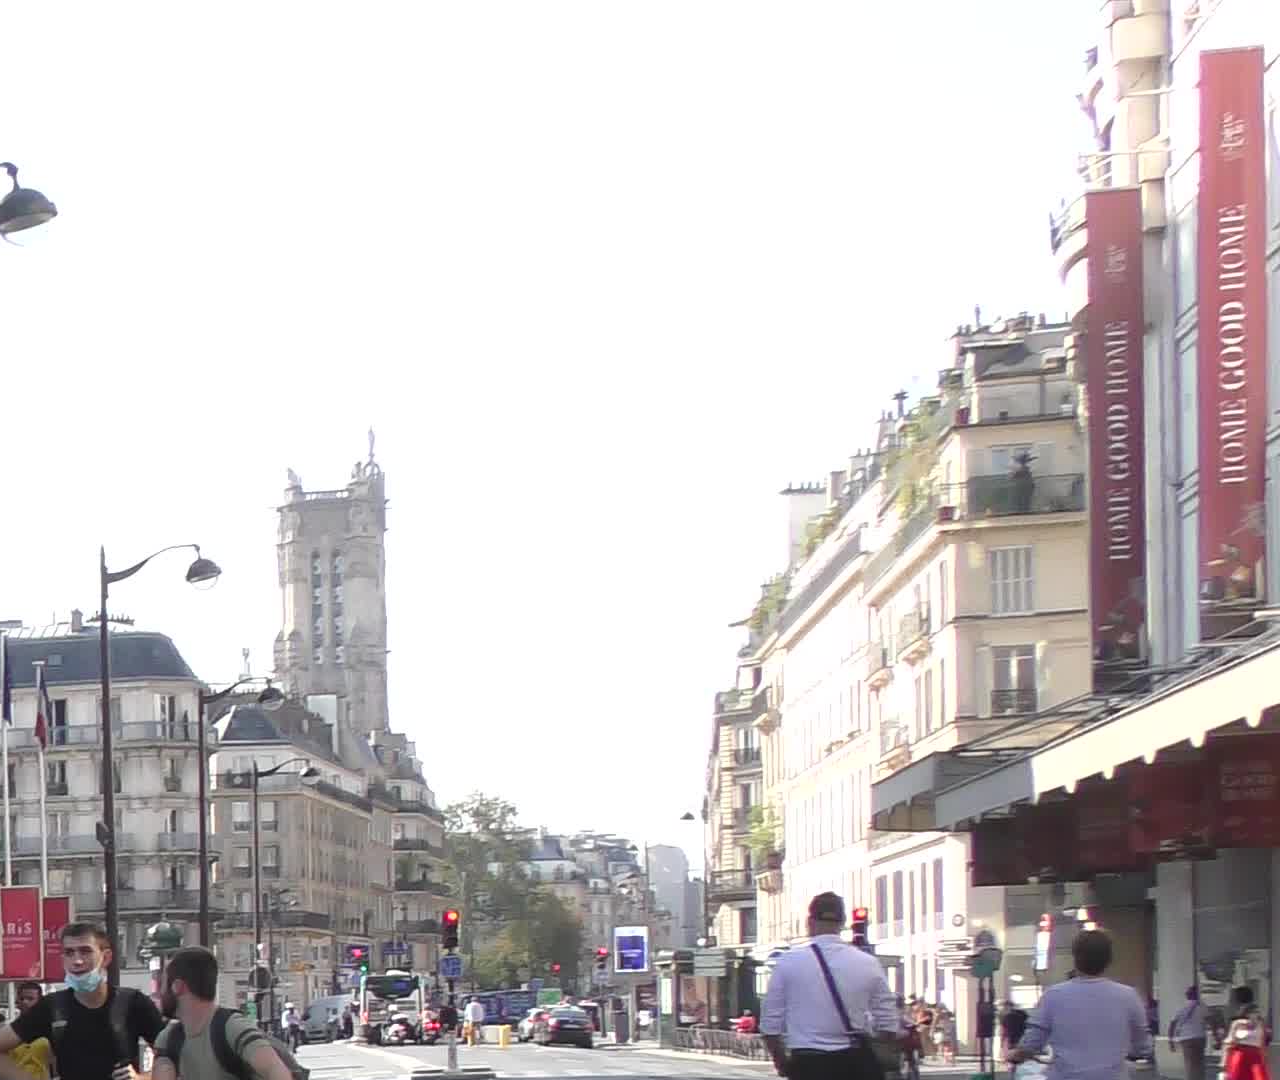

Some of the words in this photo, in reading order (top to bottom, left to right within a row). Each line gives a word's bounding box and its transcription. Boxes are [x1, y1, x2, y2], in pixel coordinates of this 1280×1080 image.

[1219, 203, 1248, 291] HOME
[1104, 320, 1129, 395] HOME
[1218, 301, 1247, 390] GOOD
[1106, 403, 1130, 481] GOOD
[1219, 399, 1248, 484] HOME
[1107, 488, 1132, 560] HOME
